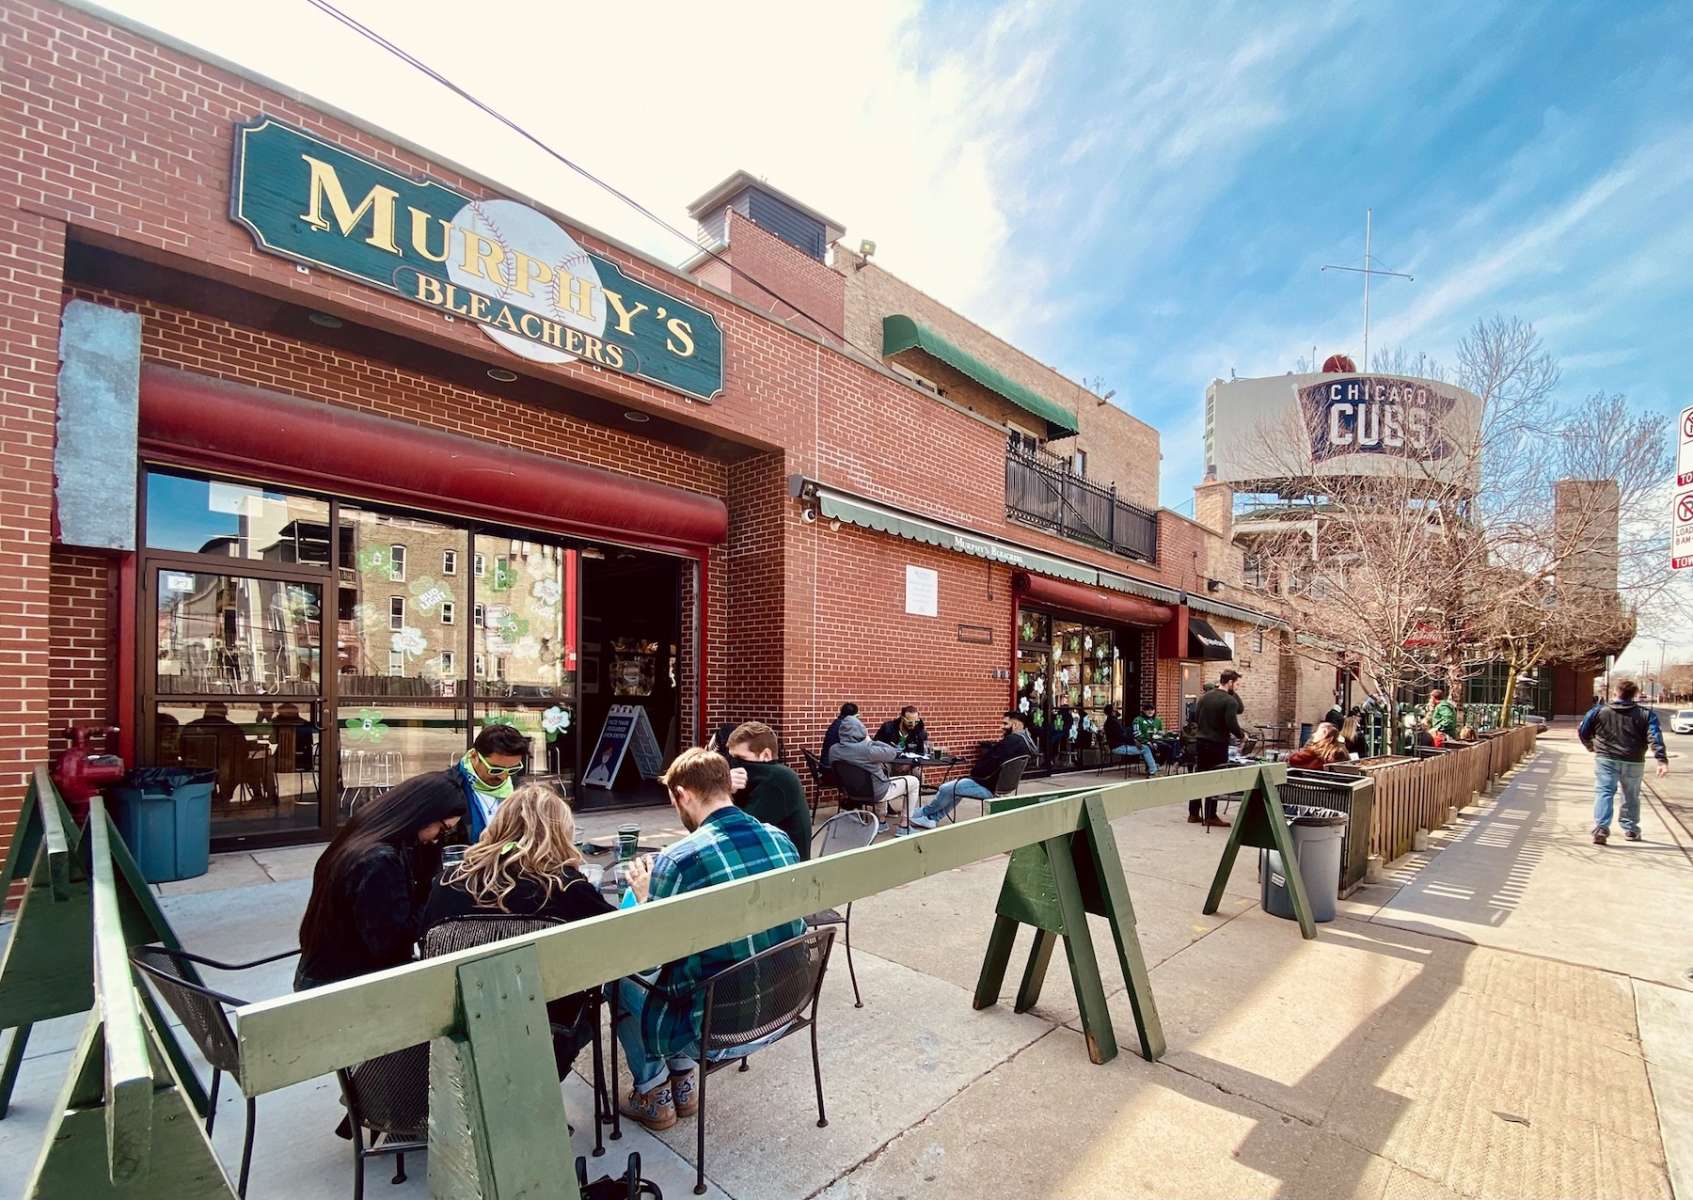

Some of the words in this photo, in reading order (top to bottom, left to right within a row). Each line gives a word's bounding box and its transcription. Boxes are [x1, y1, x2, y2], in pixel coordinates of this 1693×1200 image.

[300, 153, 695, 358] MURPHY'S
[415, 272, 624, 369] BLEACHERS
[1330, 384, 1427, 405] CHICAGO
[1330, 402, 1427, 449] CUBS
